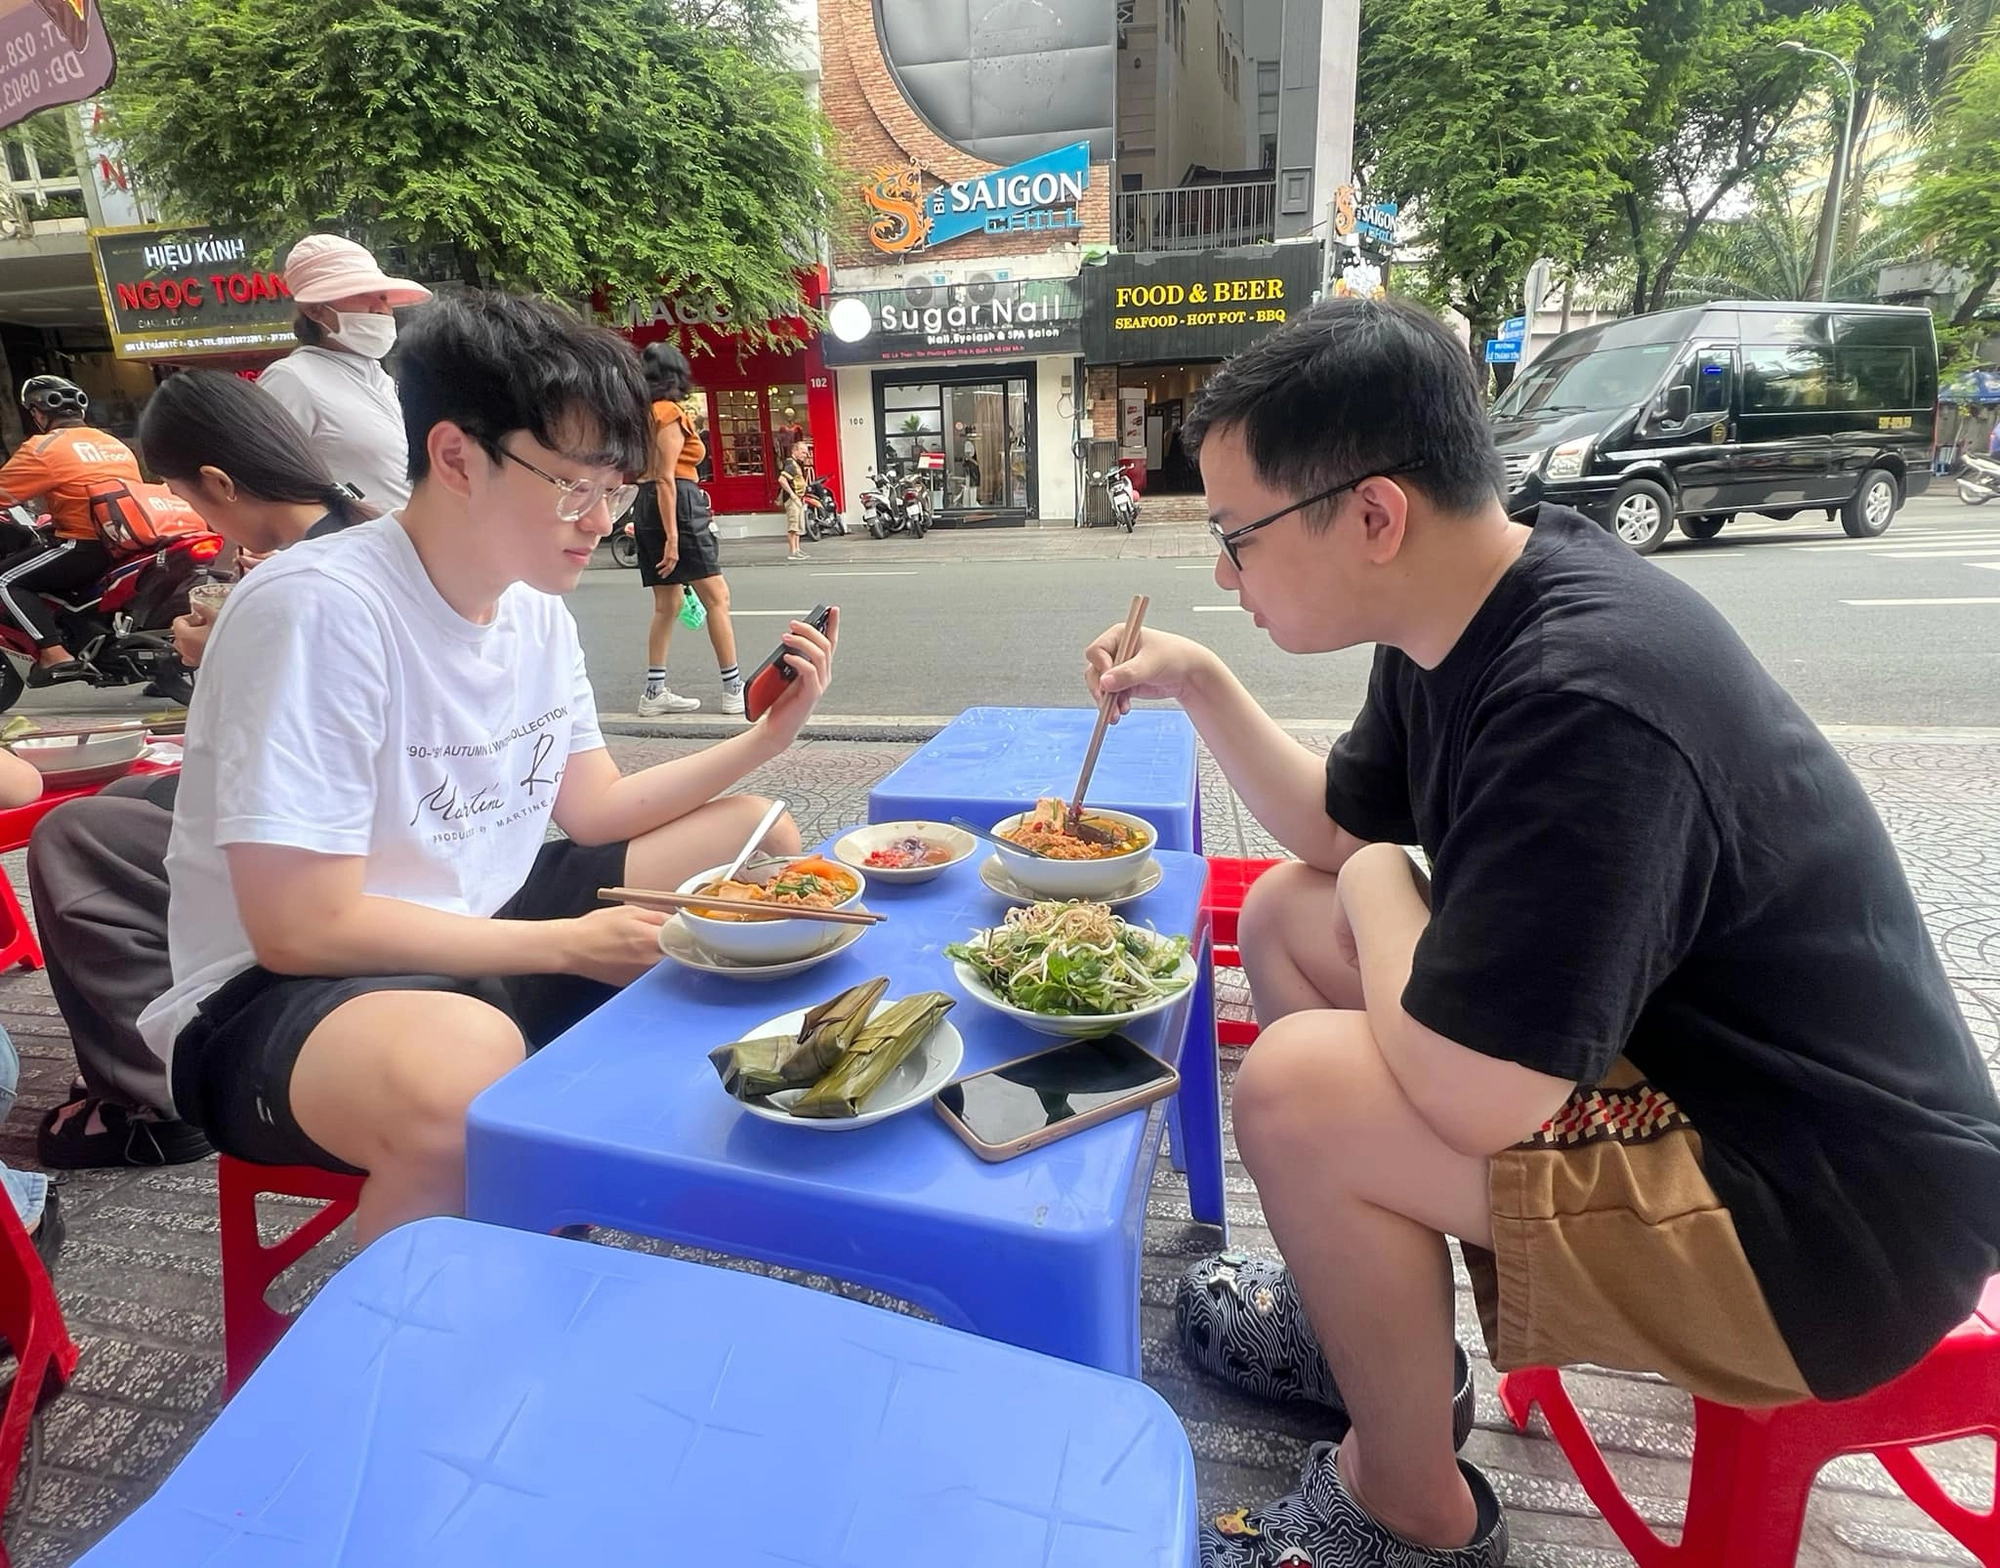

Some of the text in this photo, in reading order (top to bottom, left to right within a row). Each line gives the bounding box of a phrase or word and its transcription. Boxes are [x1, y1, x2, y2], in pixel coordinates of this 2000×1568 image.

[933, 171, 1083, 215] BIA SAIGON
[984, 208, 1084, 234] CHILL
[144, 234, 246, 271] HIỆU KÍNH
[117, 276, 204, 315] NGỌC
[1116, 279, 1284, 308] FOOD & BEER
[881, 295, 1060, 333] Sugar Nail
[1115, 315, 1178, 330] SEAFOOD
[1187, 313, 1216, 326] HOT
[1219, 311, 1246, 324] POT
[1256, 309, 1286, 323] BBQ
[1007, 330, 1026, 340] SPA
[811, 378, 828, 388] 102
[496, 799, 549, 828] MARTINE
